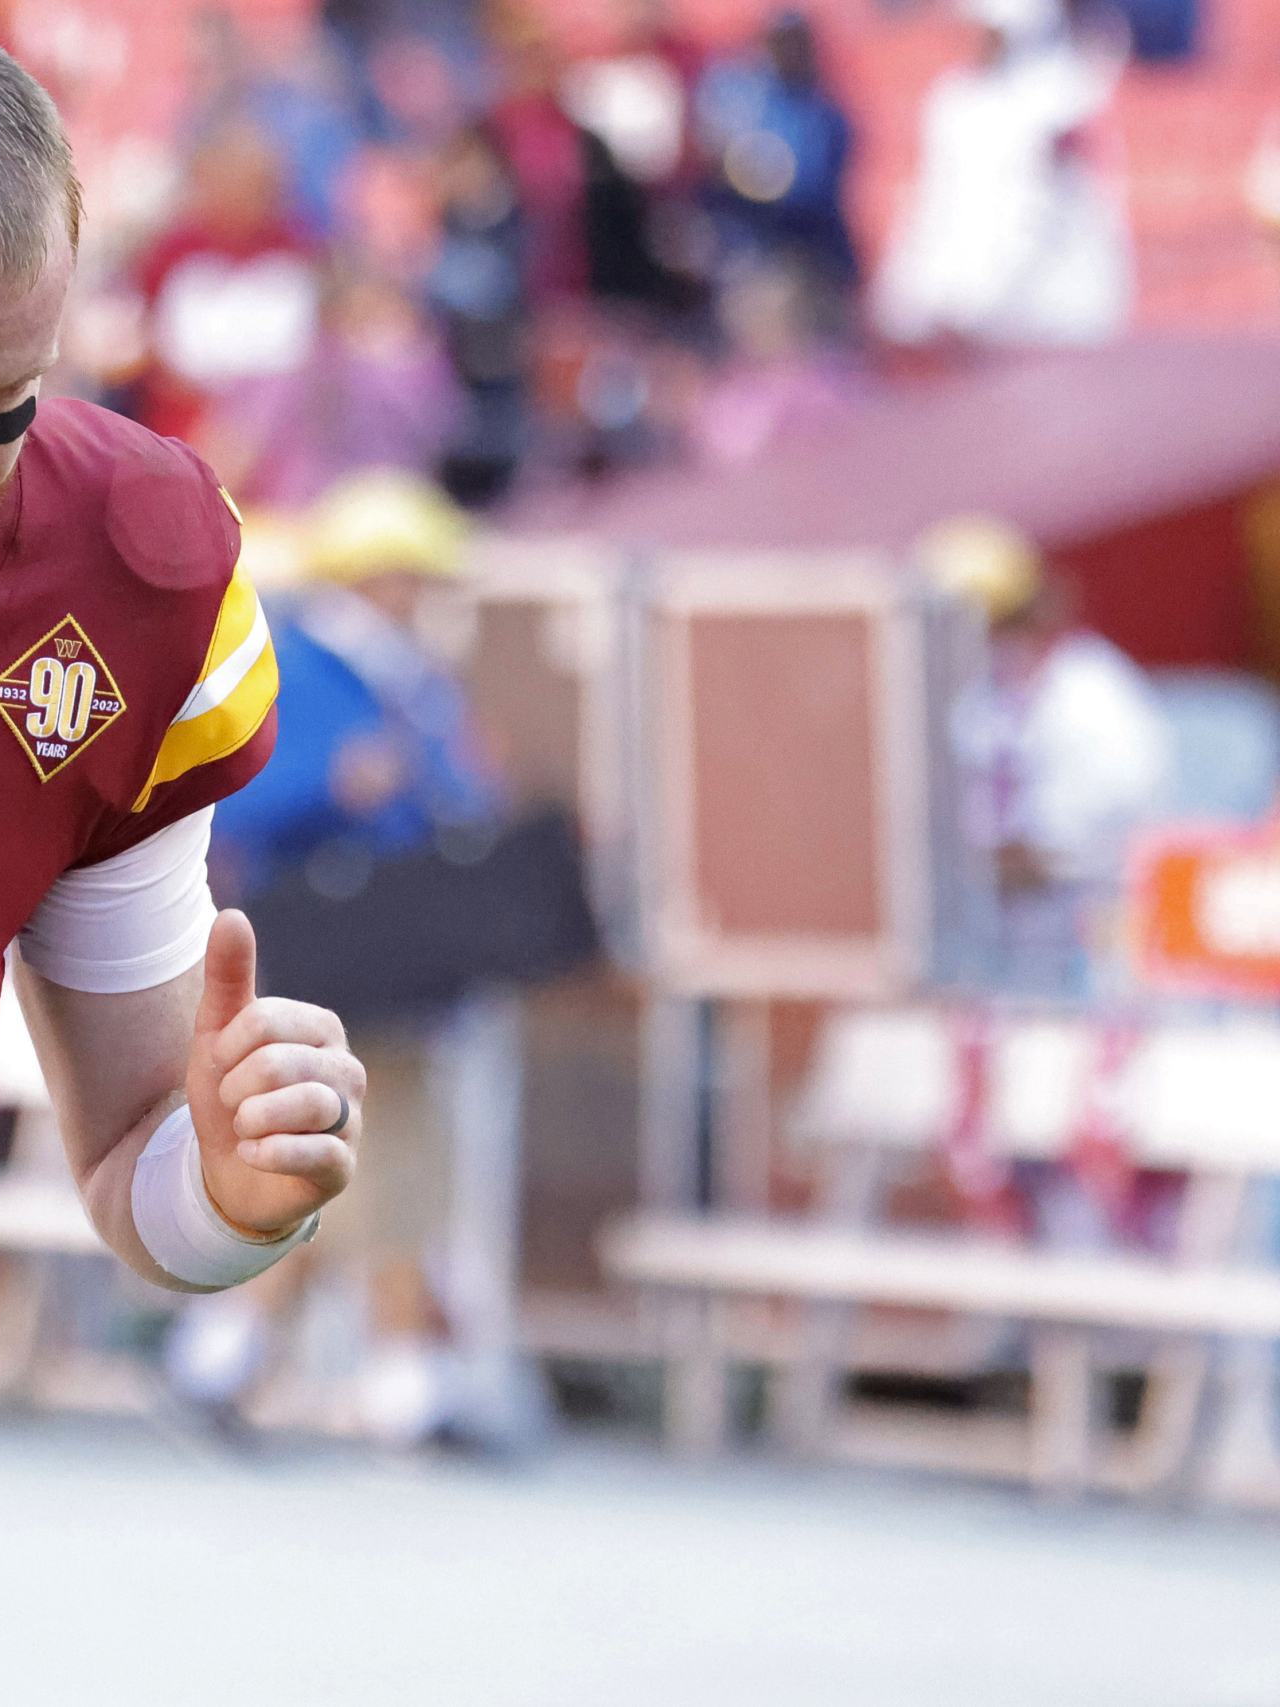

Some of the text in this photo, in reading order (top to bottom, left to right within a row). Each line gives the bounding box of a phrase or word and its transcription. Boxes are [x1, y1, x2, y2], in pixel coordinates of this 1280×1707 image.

[26, 657, 97, 742] 90
[91, 699, 119, 712] 2022
[36, 741, 67, 758] YEARS
